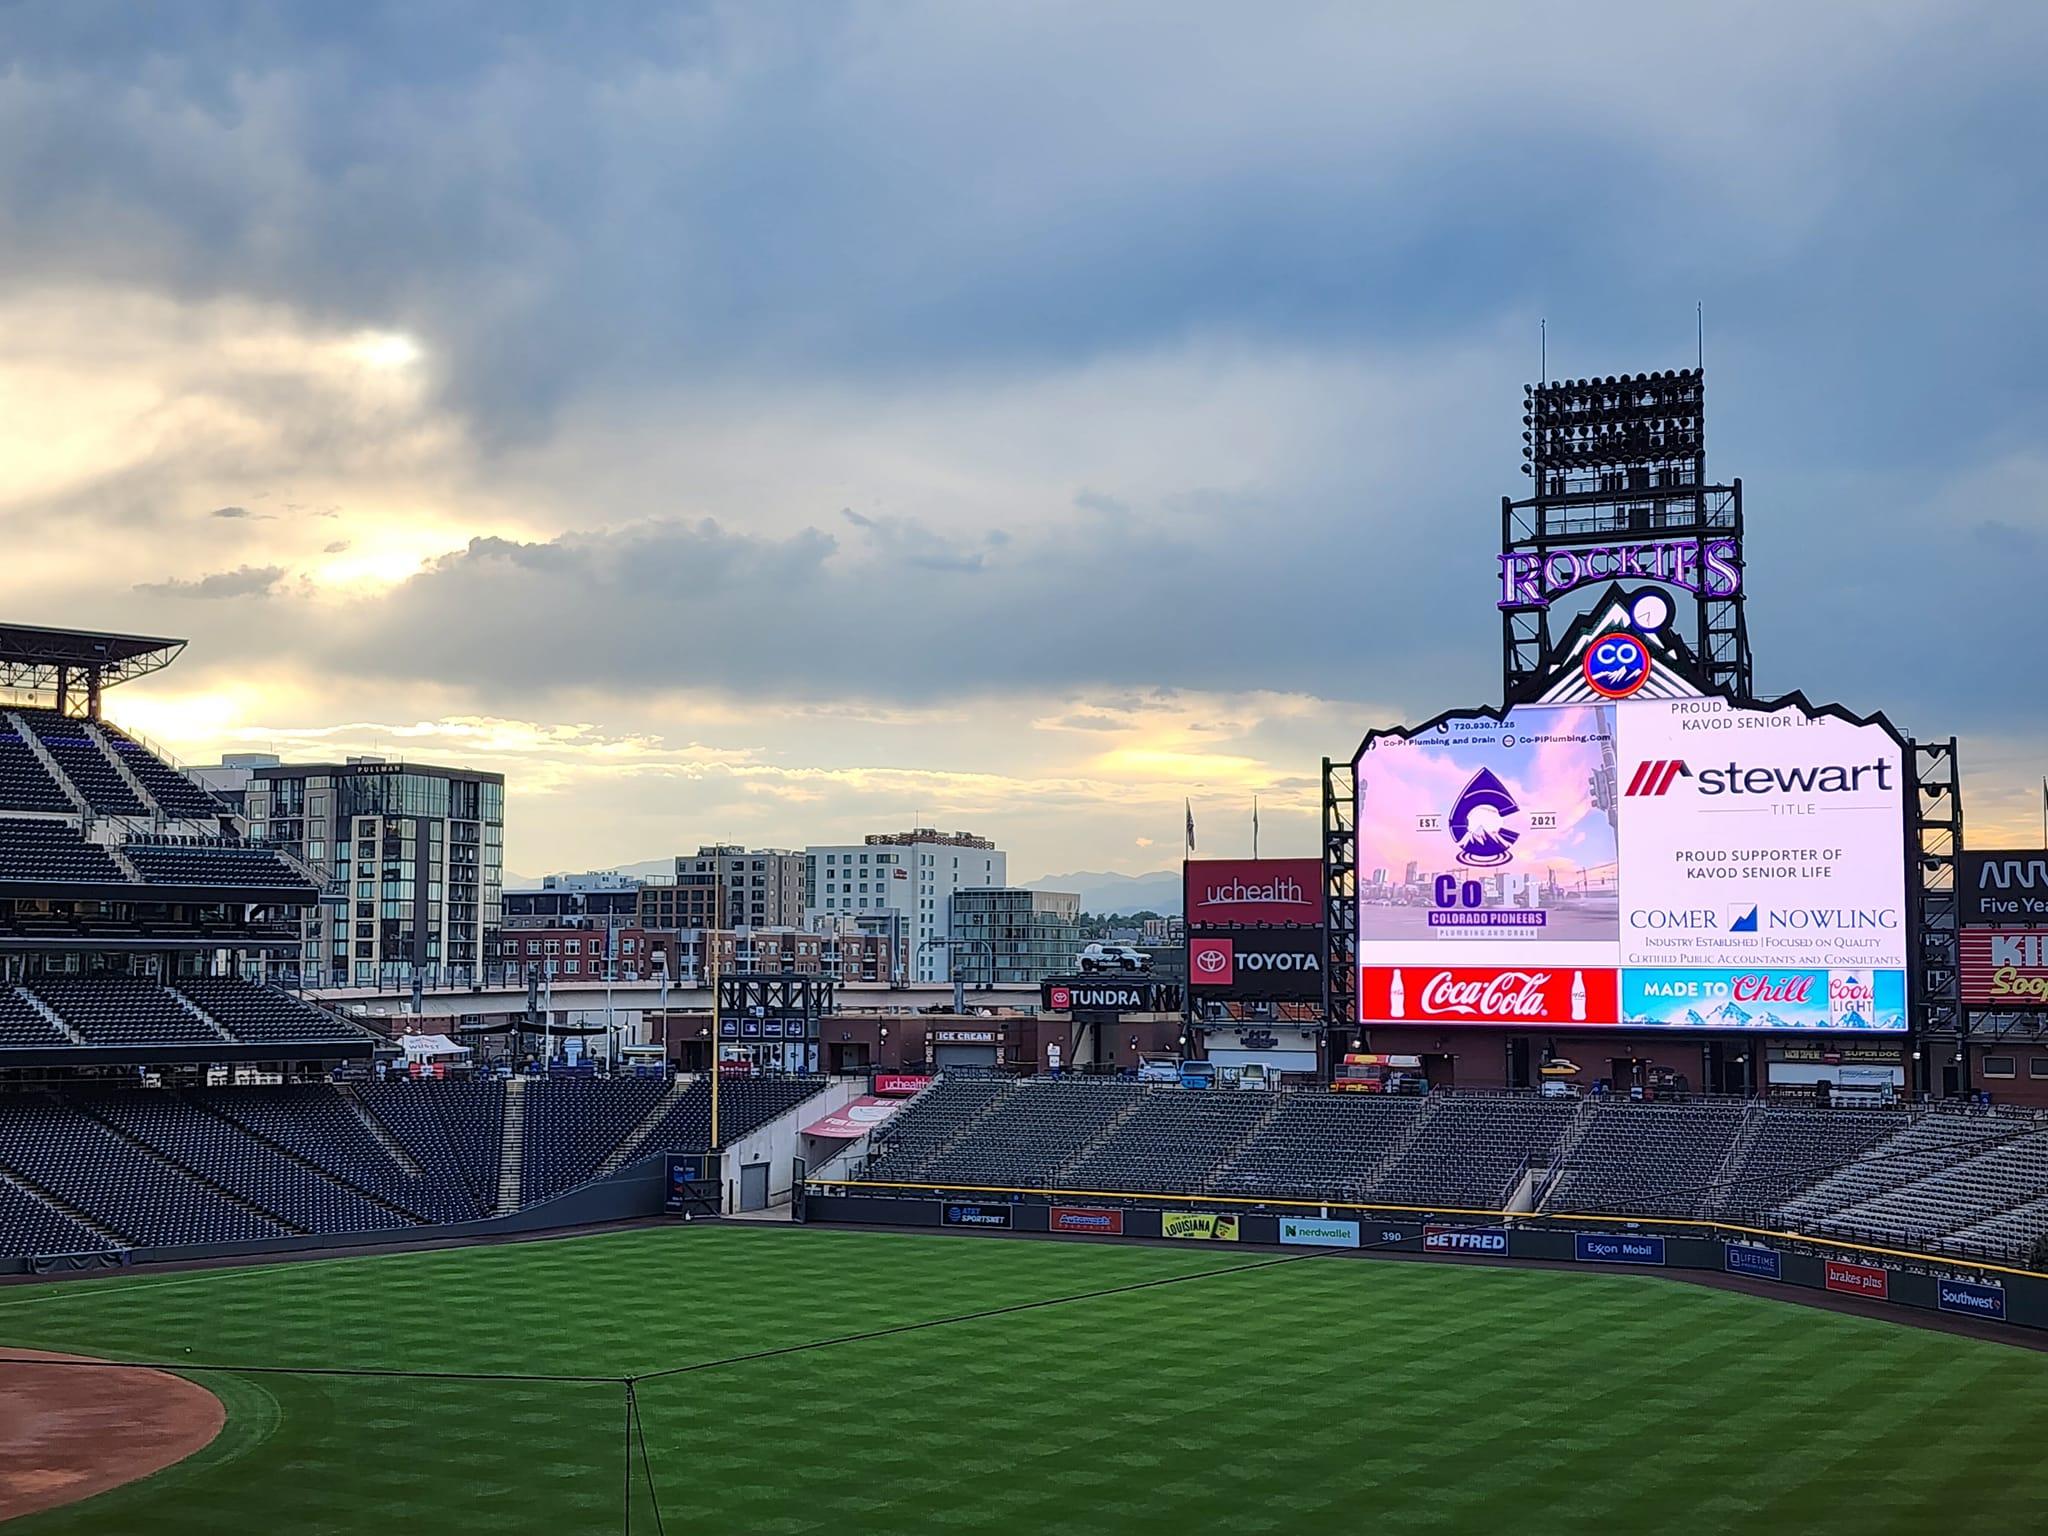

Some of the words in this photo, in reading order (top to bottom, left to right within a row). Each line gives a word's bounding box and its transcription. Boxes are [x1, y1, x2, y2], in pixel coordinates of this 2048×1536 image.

[1497, 540, 1741, 607] ROCKIES
[1596, 643, 1637, 665] CO
[1671, 702, 1722, 714] PROUD
[1682, 718, 1733, 730] KAVOD
[1737, 716, 1792, 729] SENIOR
[1796, 715, 1826, 727] LIFE
[1409, 737, 1450, 746] Plumbing
[1472, 736, 1496, 744] Drain
[357, 765, 400, 773] PULLMAN
[1697, 757, 1892, 796] stewart
[1771, 804, 1816, 815] TITLE
[1419, 818, 1439, 828] EST.
[1531, 816, 1556, 826] 2021
[1676, 850, 1727, 862] PROUD
[1732, 849, 1818, 861] SUPPORTER
[1823, 849, 1842, 860] OF
[1687, 867, 1738, 879] KAVOD
[1742, 867, 1797, 878] SENIOR
[1802, 866, 1832, 878] LIFE
[1207, 876, 1302, 902] uchealth
[1980, 898, 2019, 913] Five
[1431, 912, 1488, 925] COLORADO
[1490, 912, 1543, 925] PIONEERS
[1630, 909, 1718, 929] COMER
[1769, 909, 1898, 929] NOWLING
[1645, 936, 1693, 947] INDUSTRY
[1695, 937, 1759, 947] ESTABLISHED
[1765, 937, 1813, 947] FOCUSED
[1815, 939, 1832, 947] ON
[1834, 937, 1881, 948] QUALITY
[1234, 953, 1320, 970] TOYOTA
[1717, 954, 1796, 964] ACCOUNTANTS
[1799, 955, 1821, 964] AND
[1824, 954, 1901, 965] CONSULTANTS
[1421, 971, 1551, 1016] Coca-Cola
[1644, 982, 1698, 997] MADE
[1703, 982, 1729, 997] TO
[1732, 974, 1816, 1003] Chill
[1070, 990, 1141, 1006] TUNDRA
[1833, 1000, 1872, 1012] LIGHT
[939, 1032, 954, 1040] ICE
[957, 1032, 992, 1041] CREAM
[885, 1077, 929, 1090] uchealth
[1165, 1219, 1210, 1236] LOUISIANA
[1299, 1228, 1351, 1239] nerdwallet
[1382, 1231, 1401, 1241] 390
[1426, 1232, 1505, 1249] BETFRED
[1587, 1242, 1618, 1256] Exxon
[1622, 1244, 1652, 1255] Mobil
[1740, 1253, 1775, 1267] LIFETIME
[1830, 1269, 1861, 1285] brakes
[1863, 1274, 1883, 1289] plus
[1942, 1289, 1994, 1309] Southwest
